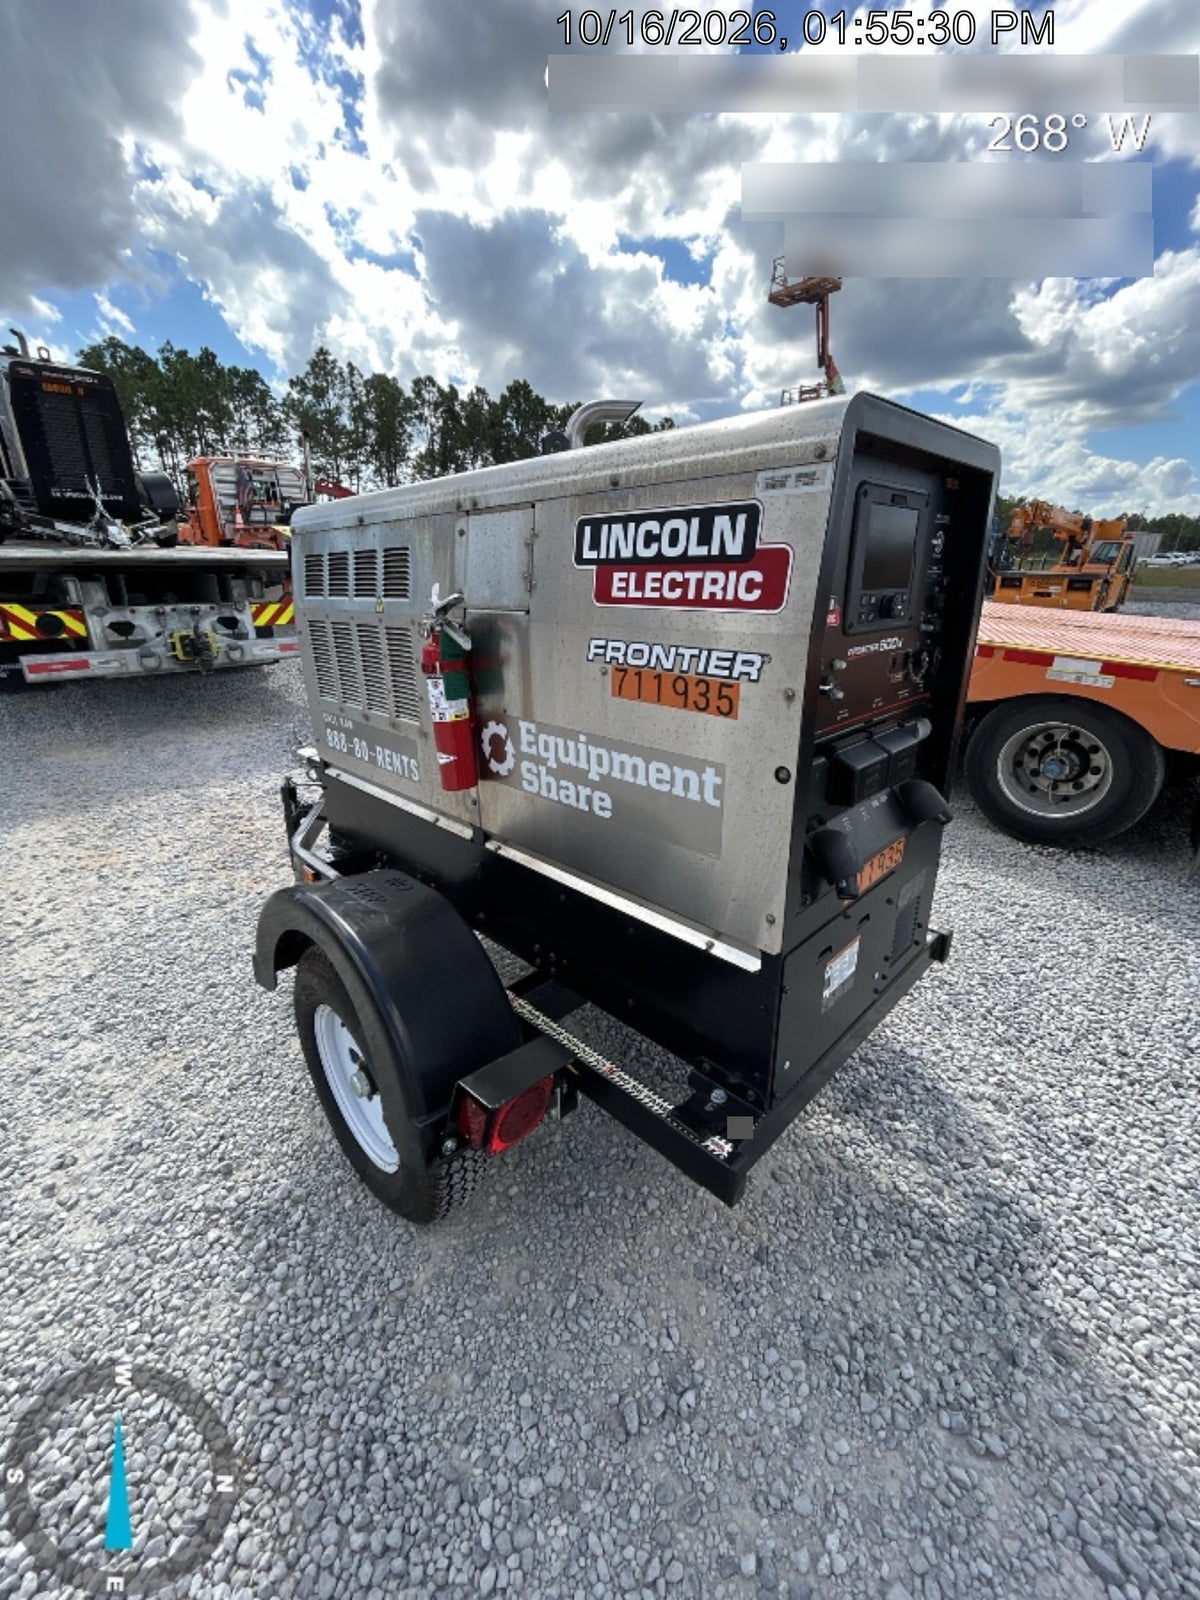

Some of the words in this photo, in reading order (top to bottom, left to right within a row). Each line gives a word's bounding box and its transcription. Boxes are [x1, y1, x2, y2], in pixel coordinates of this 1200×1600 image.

[582, 514, 748, 559] LINCOLN
[611, 570, 764, 602] ELECTRIC
[587, 638, 766, 682] FRONTIER
[614, 668, 734, 716] 711935
[325, 727, 419, 782] 888-80-RENTS
[518, 719, 723, 808] Equipment
[519, 760, 613, 819] Share
